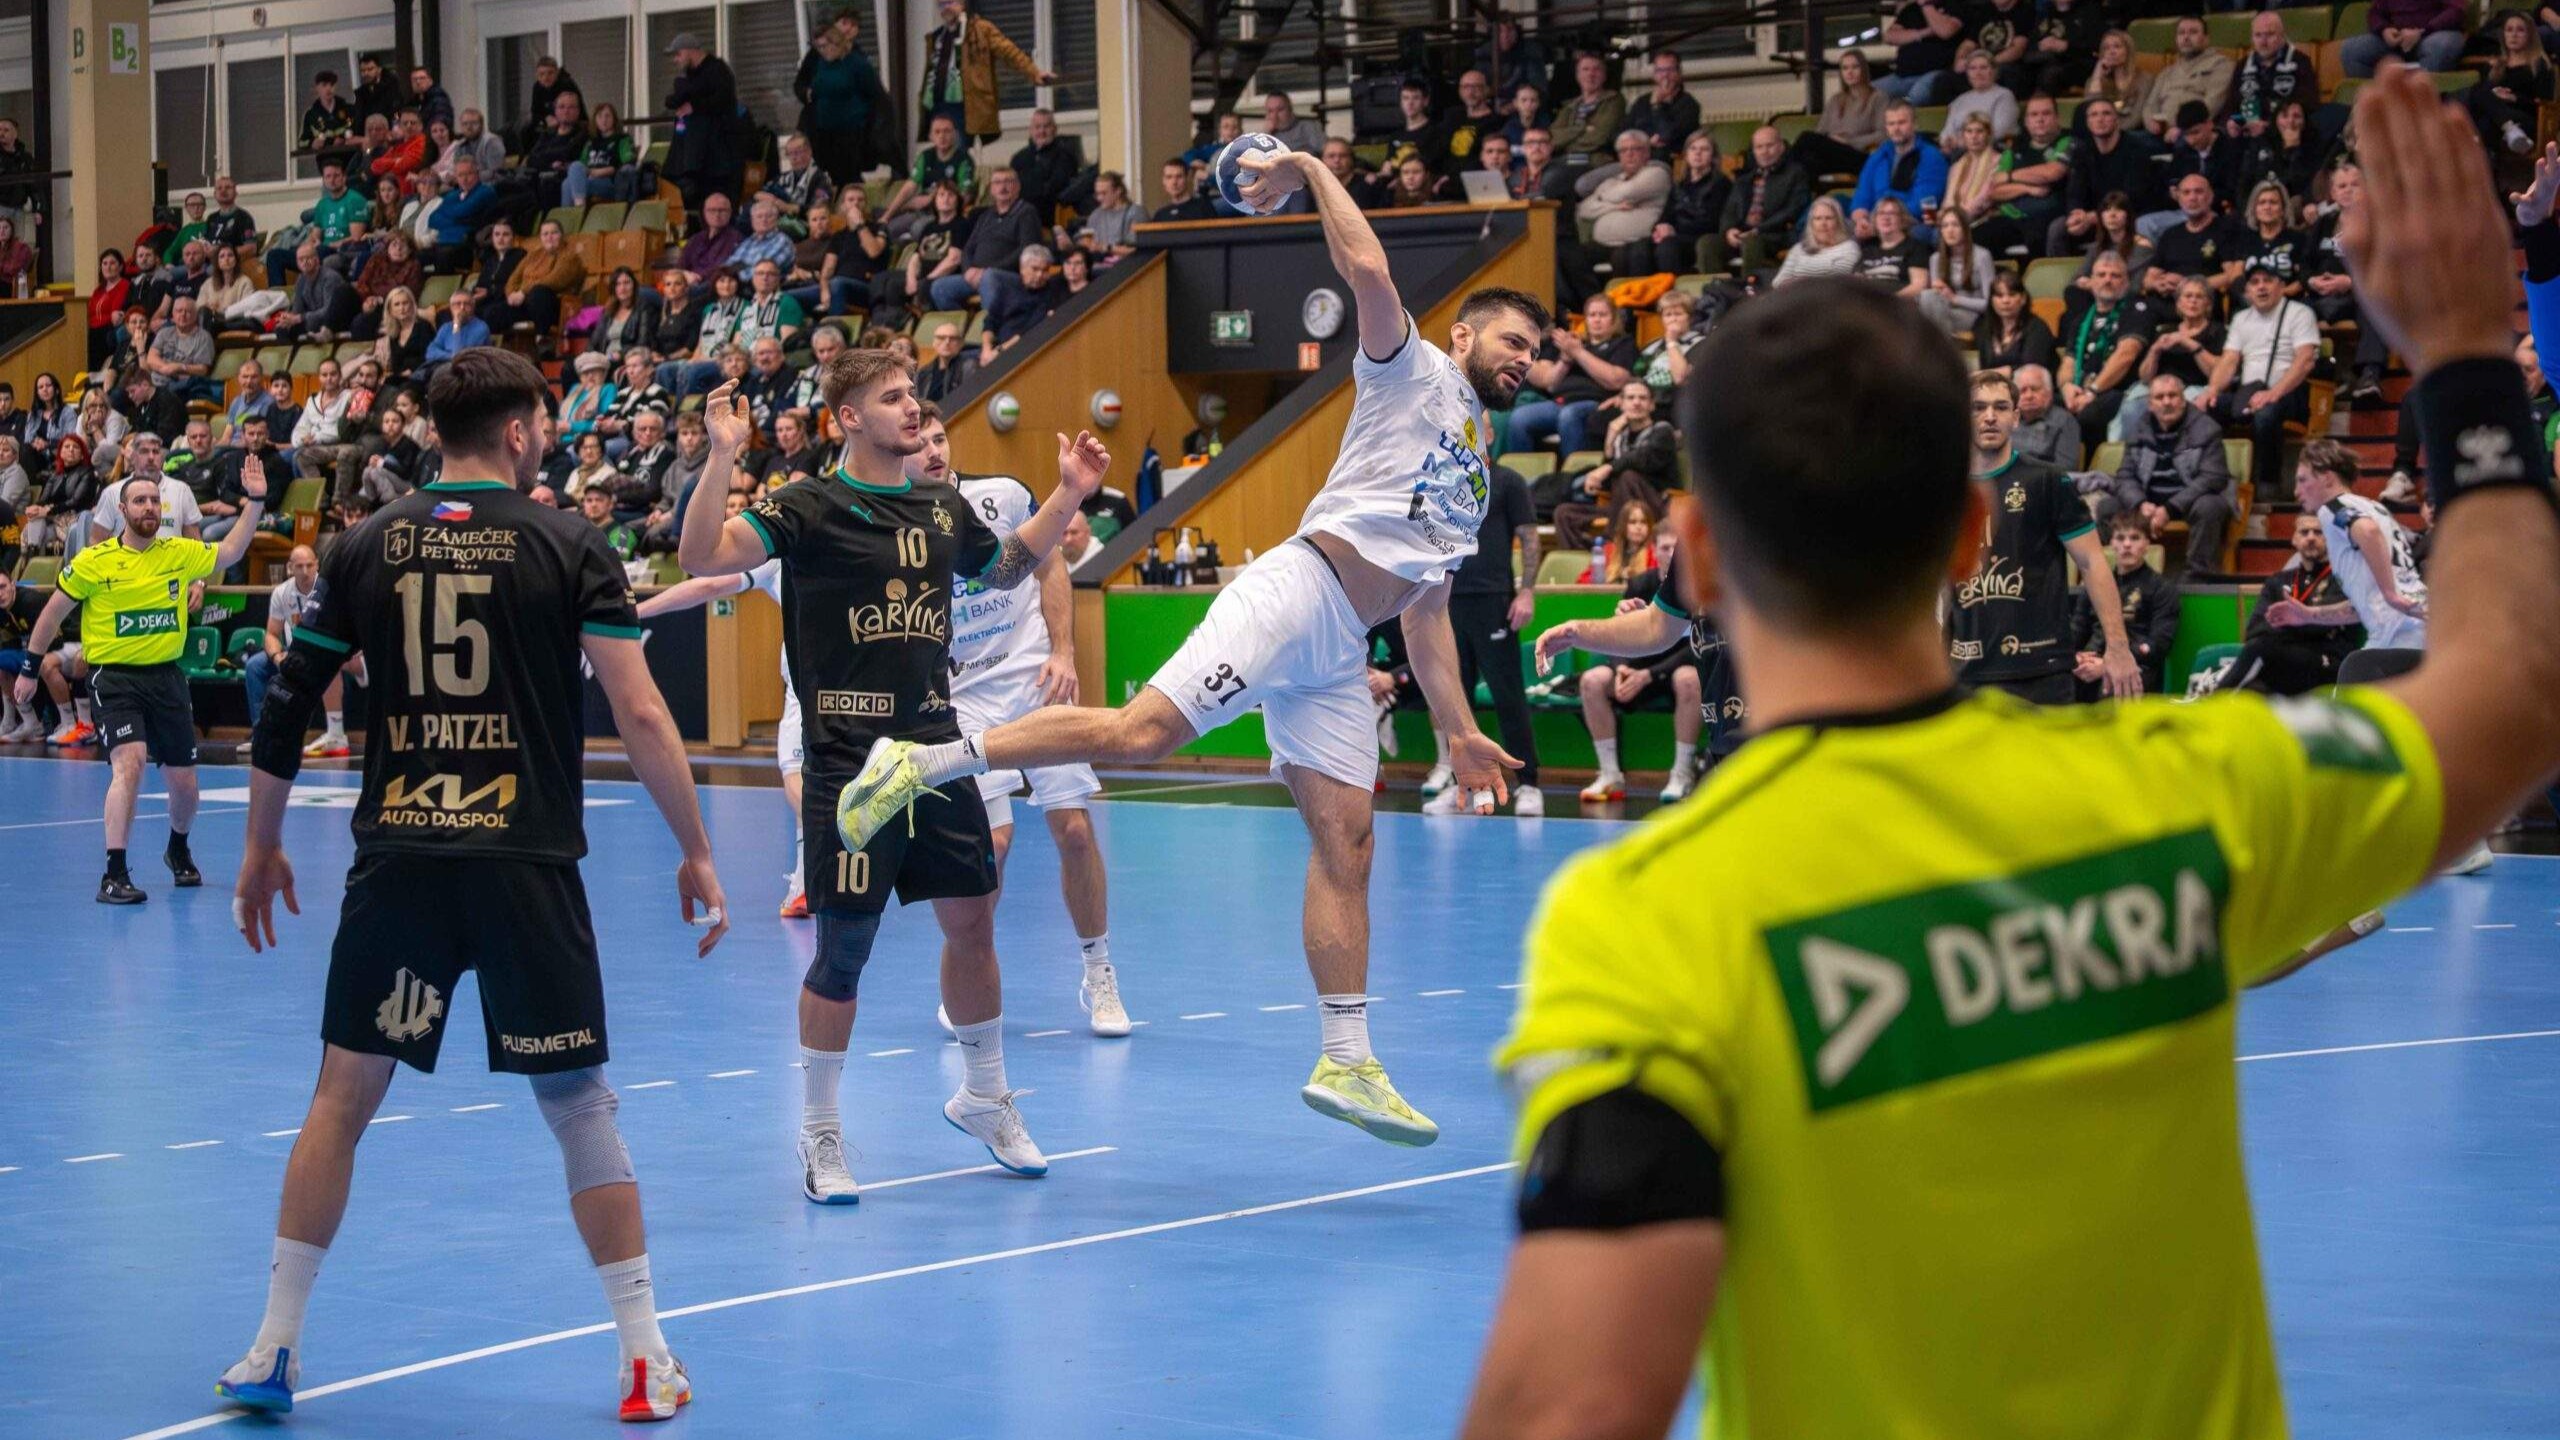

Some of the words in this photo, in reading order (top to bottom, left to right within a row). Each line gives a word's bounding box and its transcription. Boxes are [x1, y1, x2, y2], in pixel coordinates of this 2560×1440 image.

[73, 27, 84, 58] B
[982, 497, 998, 521] 8
[421, 526, 519, 547] ZÁMEČEK
[896, 527, 928, 569] 10
[420, 544, 516, 563] PETROVICE
[970, 592, 1014, 618] BANK
[139, 612, 177, 630] DEKRA
[394, 571, 493, 697] 15
[1204, 662, 1248, 707] 37
[387, 715, 415, 752] V.
[422, 713, 518, 750] PATZEL
[379, 810, 428, 826] AUTO
[431, 811, 510, 828] DASPOL
[837, 850, 870, 895] 10
[1926, 869, 2217, 1028] DEKRA
[502, 1027, 597, 1055] PLUSMETAL
